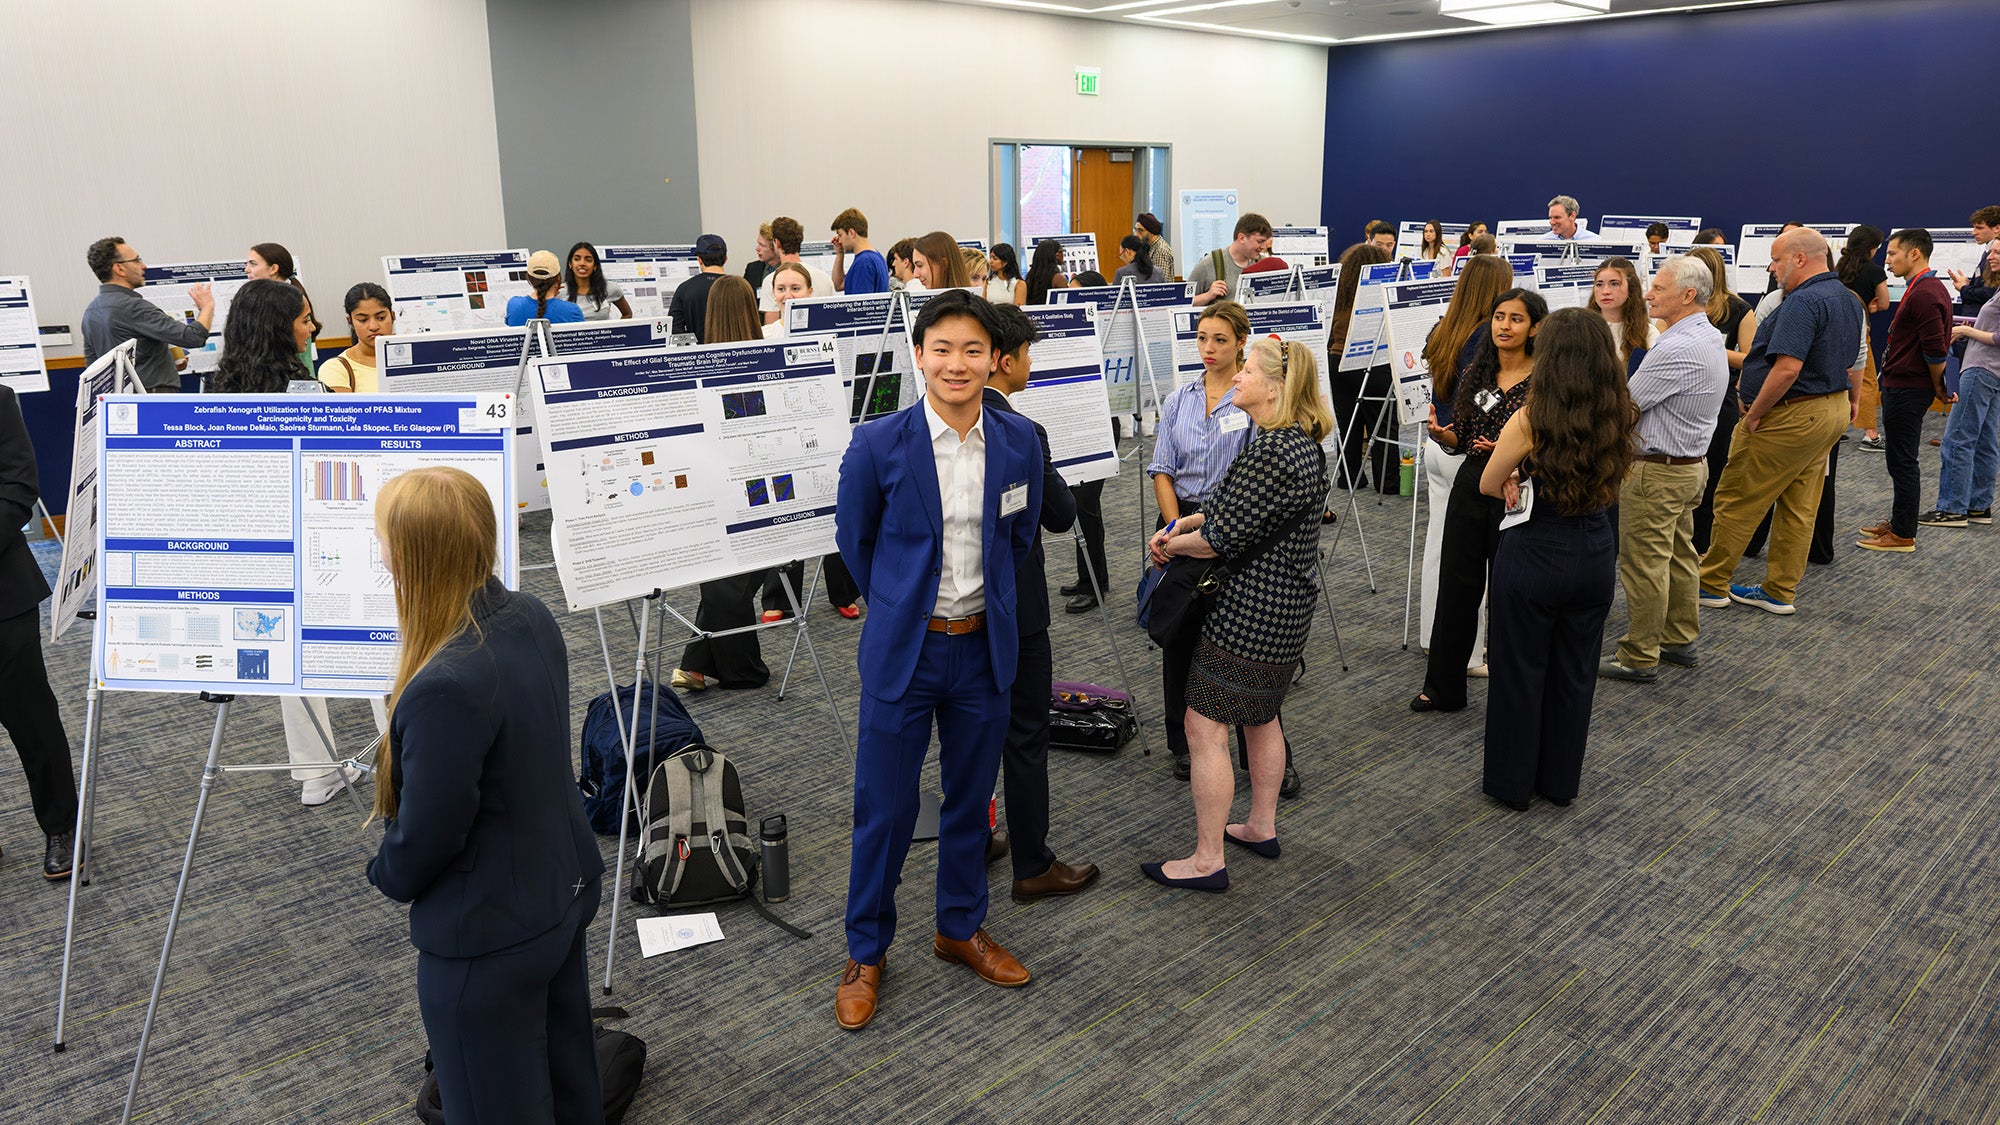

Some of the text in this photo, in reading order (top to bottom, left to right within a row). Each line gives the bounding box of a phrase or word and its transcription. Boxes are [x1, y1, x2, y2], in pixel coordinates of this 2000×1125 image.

[1081, 75, 1097, 92] EXIT
[1087, 306, 1094, 317] 45
[656, 324, 668, 333] 91
[822, 342, 834, 352] 44
[649, 356, 663, 364] Glial
[663, 355, 697, 363] Senescence
[705, 350, 731, 360] Cognitive
[731, 349, 763, 358] Dysfunction
[437, 362, 486, 372] BACKGROUND
[668, 357, 728, 368] Traumatic Brain Injury
[757, 372, 785, 381] RESULTS
[598, 386, 649, 398] BACKGROUND
[194, 406, 422, 415] Zebrafish Xenograft Utilization for the Evaluation of PFAS Mixture
[486, 403, 507, 418] 43
[257, 415, 313, 424] Carcinogenicity
[329, 415, 357, 424] Toxicity
[163, 424, 183, 432] Tessa
[184, 424, 206, 433] Block,
[207, 424, 225, 432] Joan
[226, 424, 248, 432] Renee
[249, 424, 278, 433] DeMaio,
[279, 424, 306, 432] Saoirse
[310, 425, 345, 433] Sturmann,
[363, 425, 392, 434] Skopec,
[407, 425, 442, 434] Glasgow
[443, 425, 456, 433] (PI)
[614, 431, 649, 442] METHODS
[175, 440, 221, 448] ABSTRACT
[380, 440, 422, 449] RESULTS
[772, 510, 816, 524] CONCLUSIONS
[167, 541, 229, 550] BACKGROUND
[177, 591, 220, 600] METHODS
